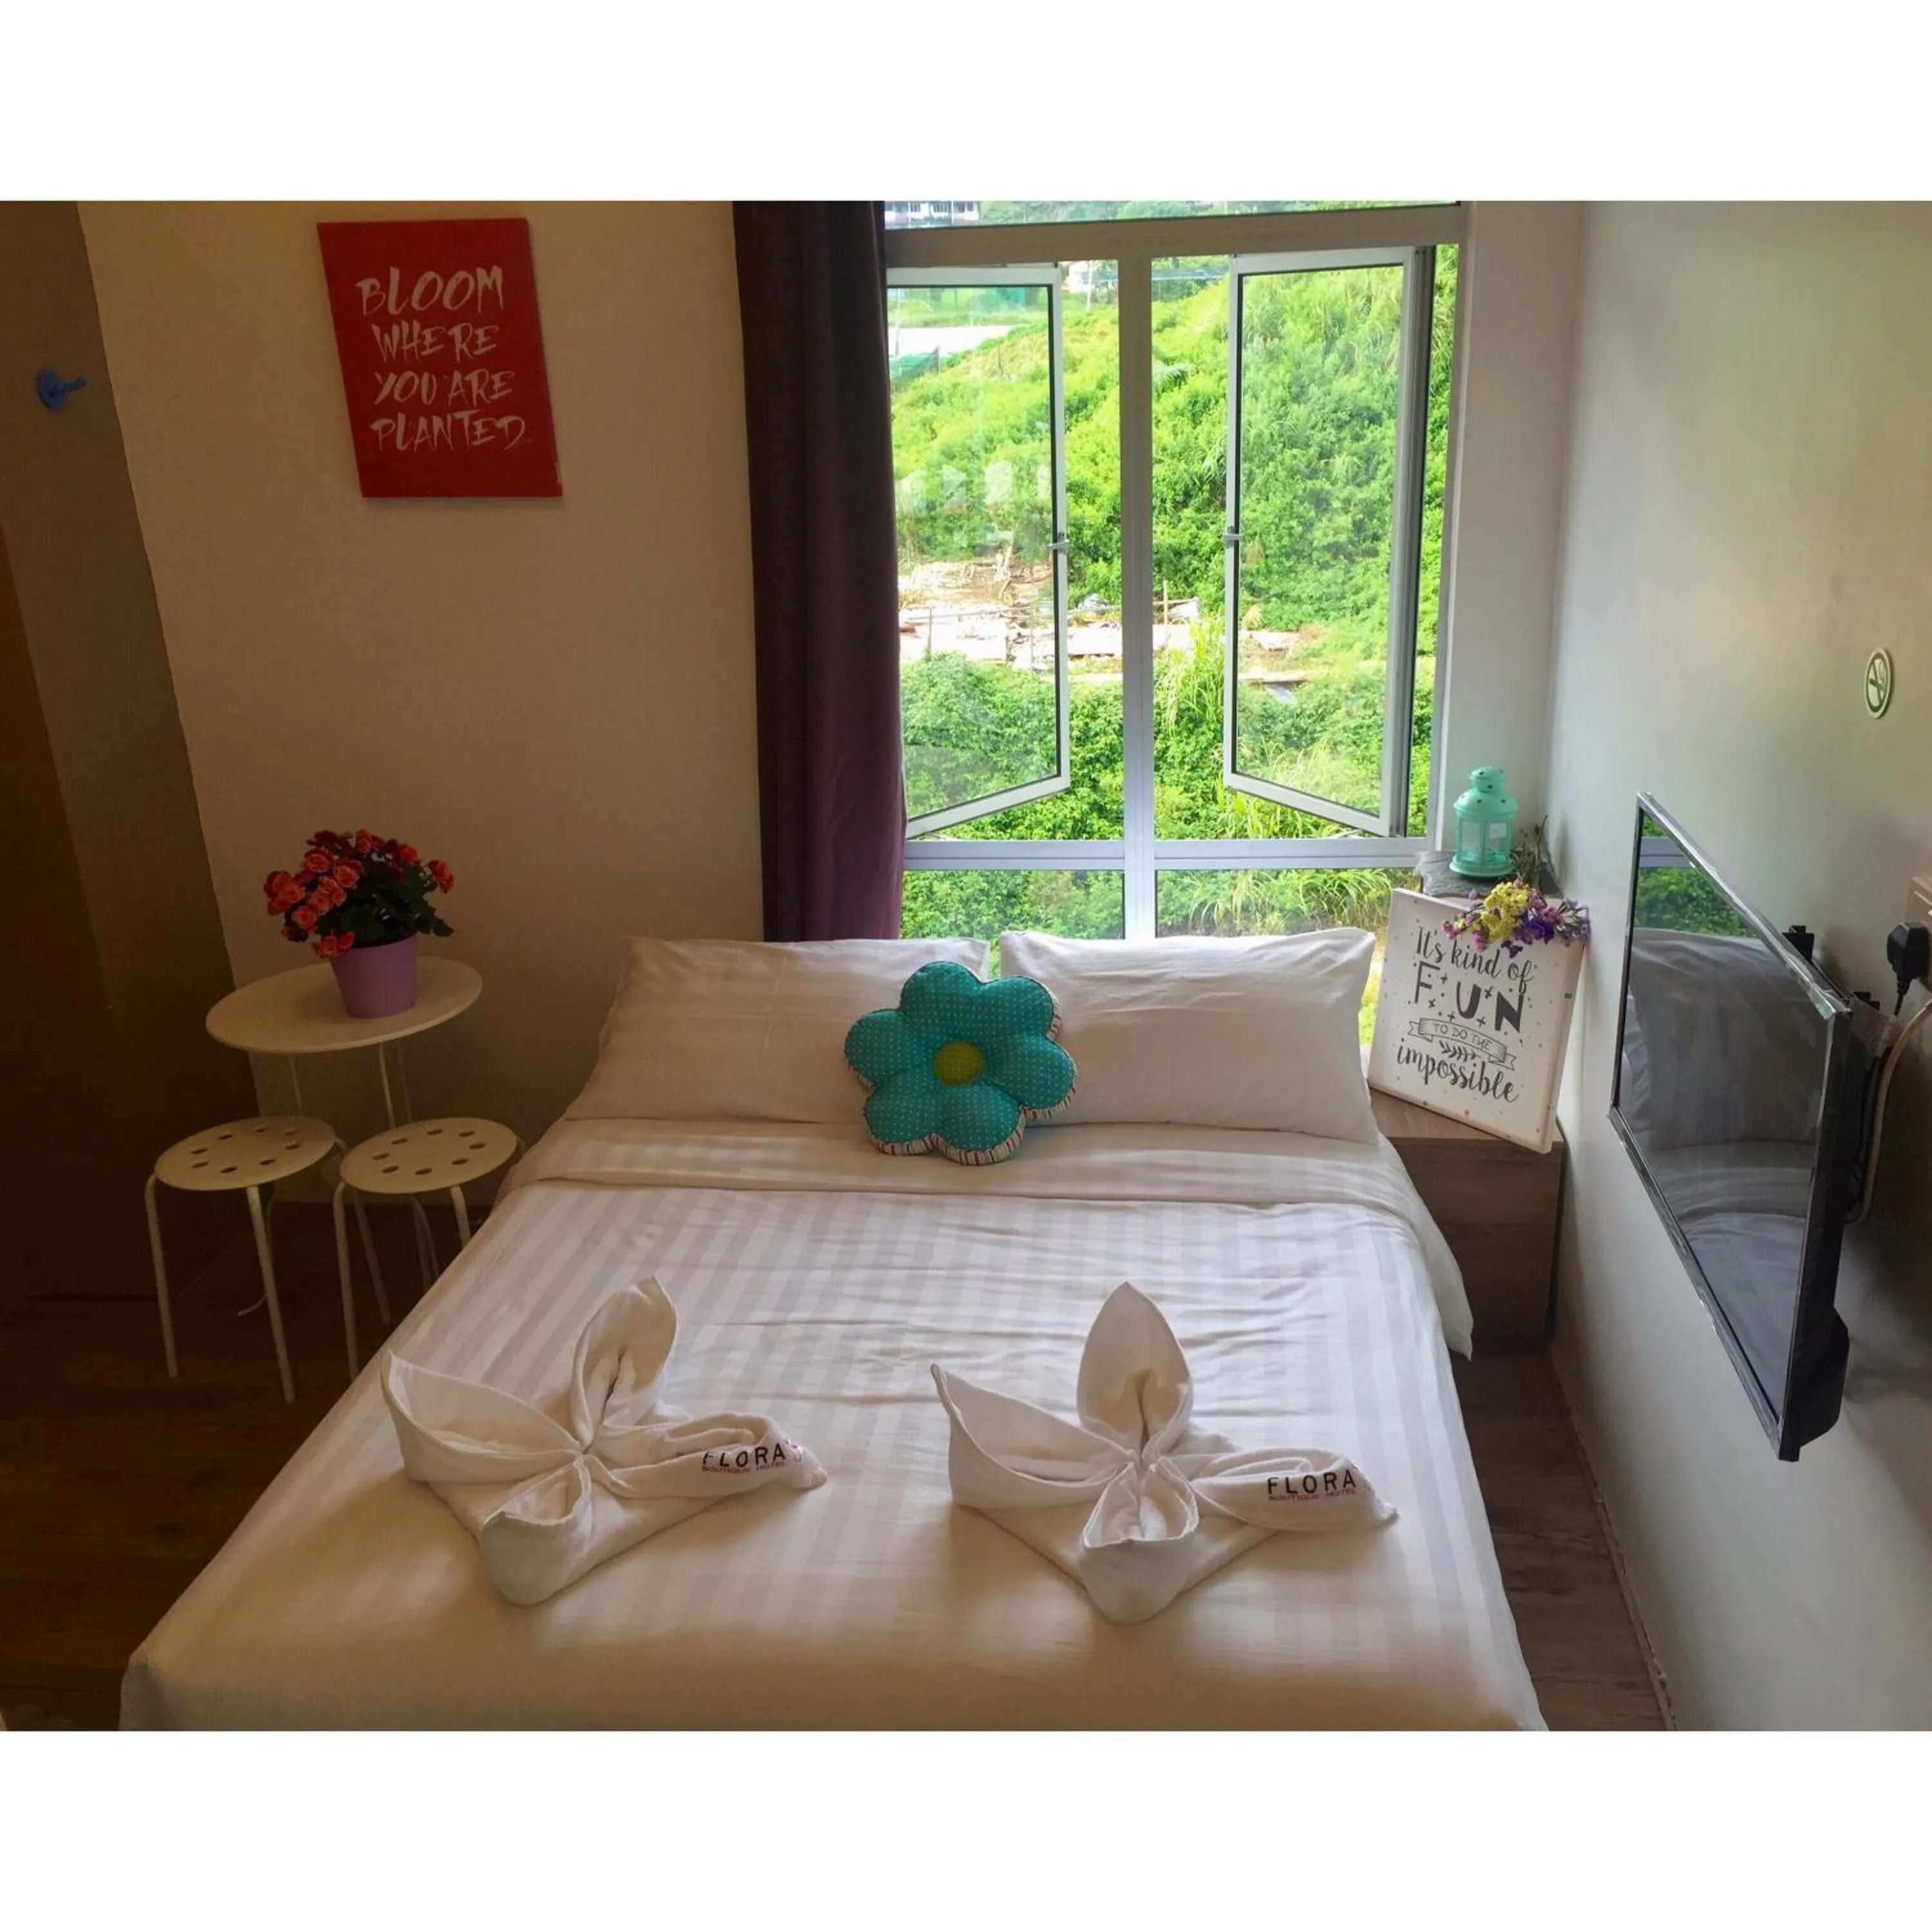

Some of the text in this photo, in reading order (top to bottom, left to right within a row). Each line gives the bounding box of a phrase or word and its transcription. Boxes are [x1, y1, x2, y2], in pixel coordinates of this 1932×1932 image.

[355, 265, 504, 316] BLOOM
[372, 319, 500, 362] WHERE
[374, 368, 516, 407] YOU ARE
[369, 410, 526, 452] PLANTED
[1416, 925, 1535, 994] It's kind of
[1414, 961, 1524, 1032] FUN
[1434, 1023, 1492, 1050] TO DO THE
[1397, 1038, 1520, 1103] impossible
[702, 1443, 786, 1468] FLORA
[1267, 1469, 1357, 1495] FLORA
